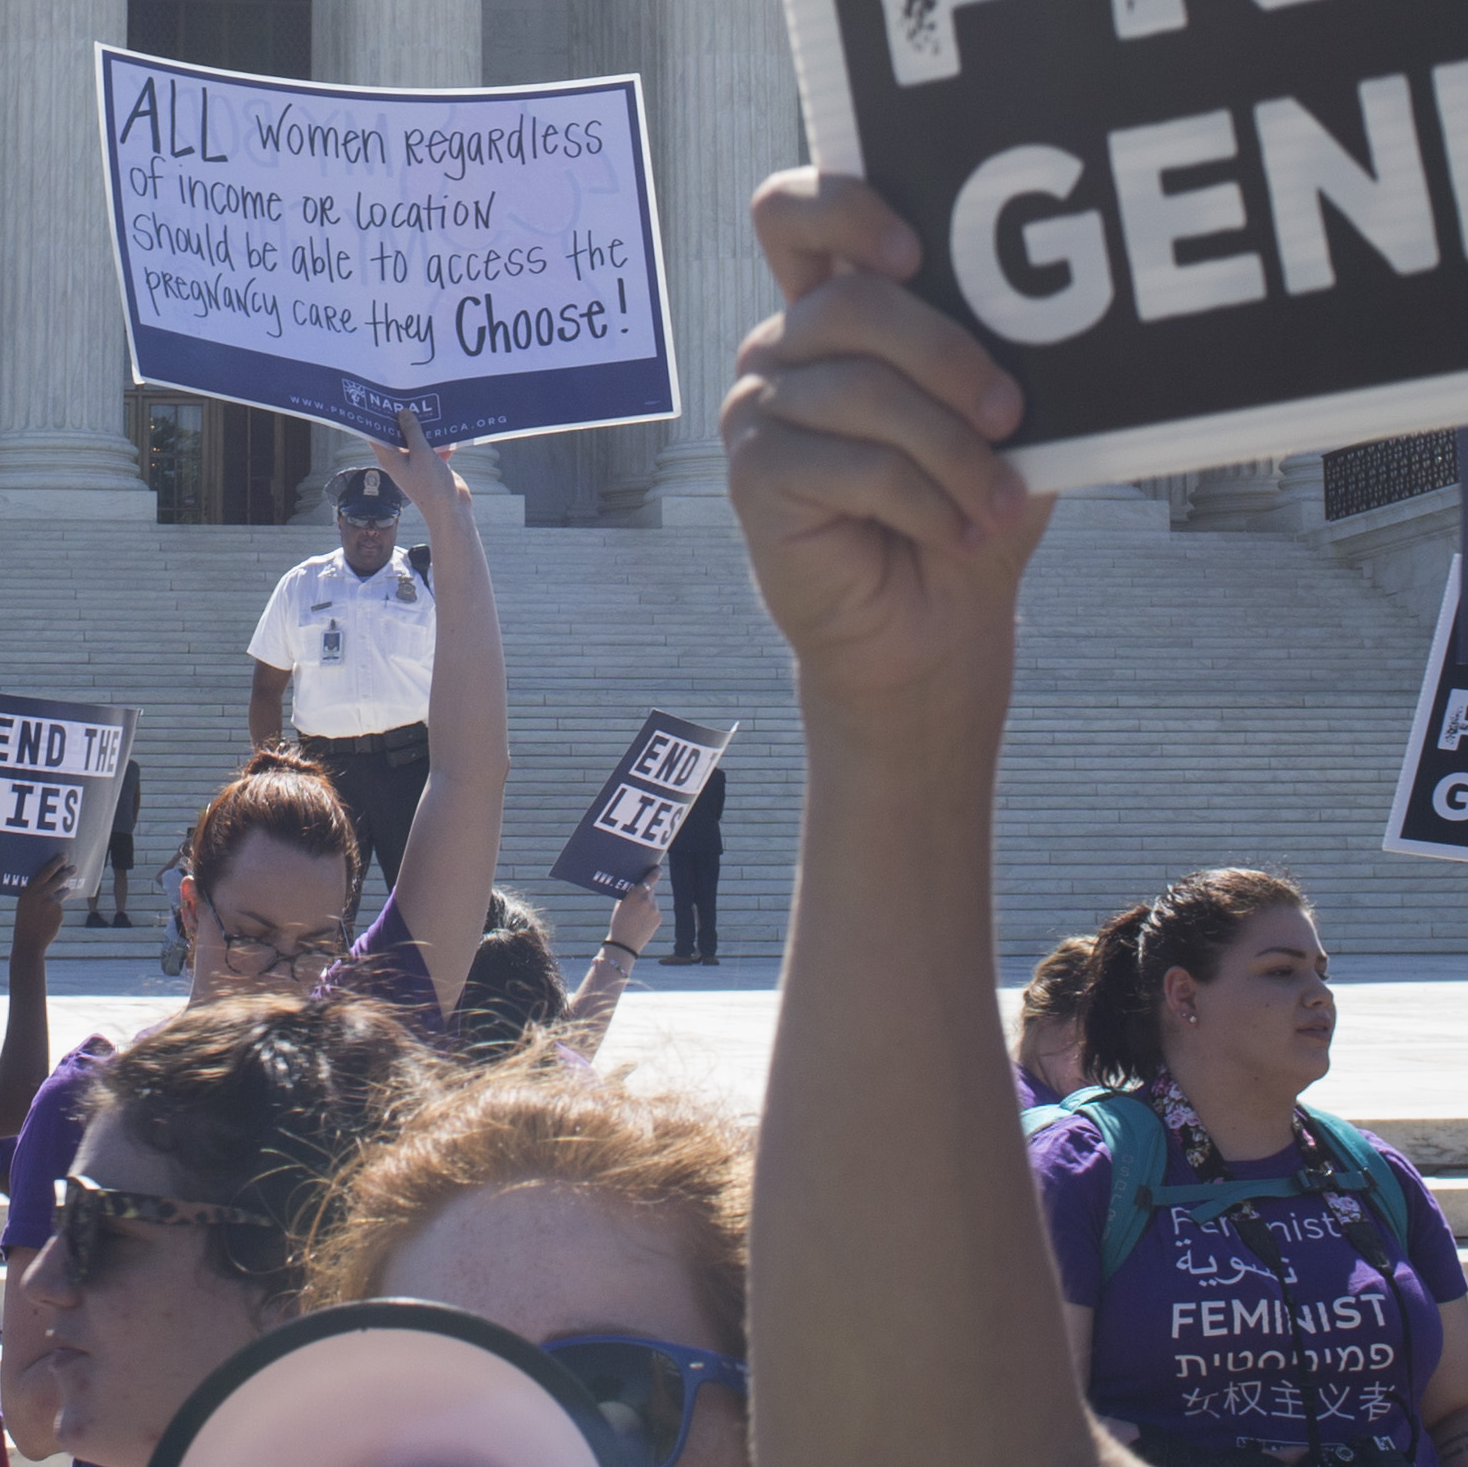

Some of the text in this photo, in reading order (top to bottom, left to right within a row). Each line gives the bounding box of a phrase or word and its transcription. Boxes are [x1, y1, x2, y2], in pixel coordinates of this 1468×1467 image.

[119, 76, 229, 163] ALL
[130, 156, 166, 200] of
[178, 164, 282, 222] income
[246, 232, 278, 272] be
[291, 236, 353, 283] able
[370, 241, 408, 283] to
[426, 246, 547, 290] access
[565, 230, 628, 281] the
[364, 299, 435, 366] they
[455, 277, 629, 357] Choose!
[84, 727, 120, 773] THE
[633, 734, 701, 787] END
[599, 787, 684, 846] LIES
[1171, 1293, 1387, 1339] FEMINIST
